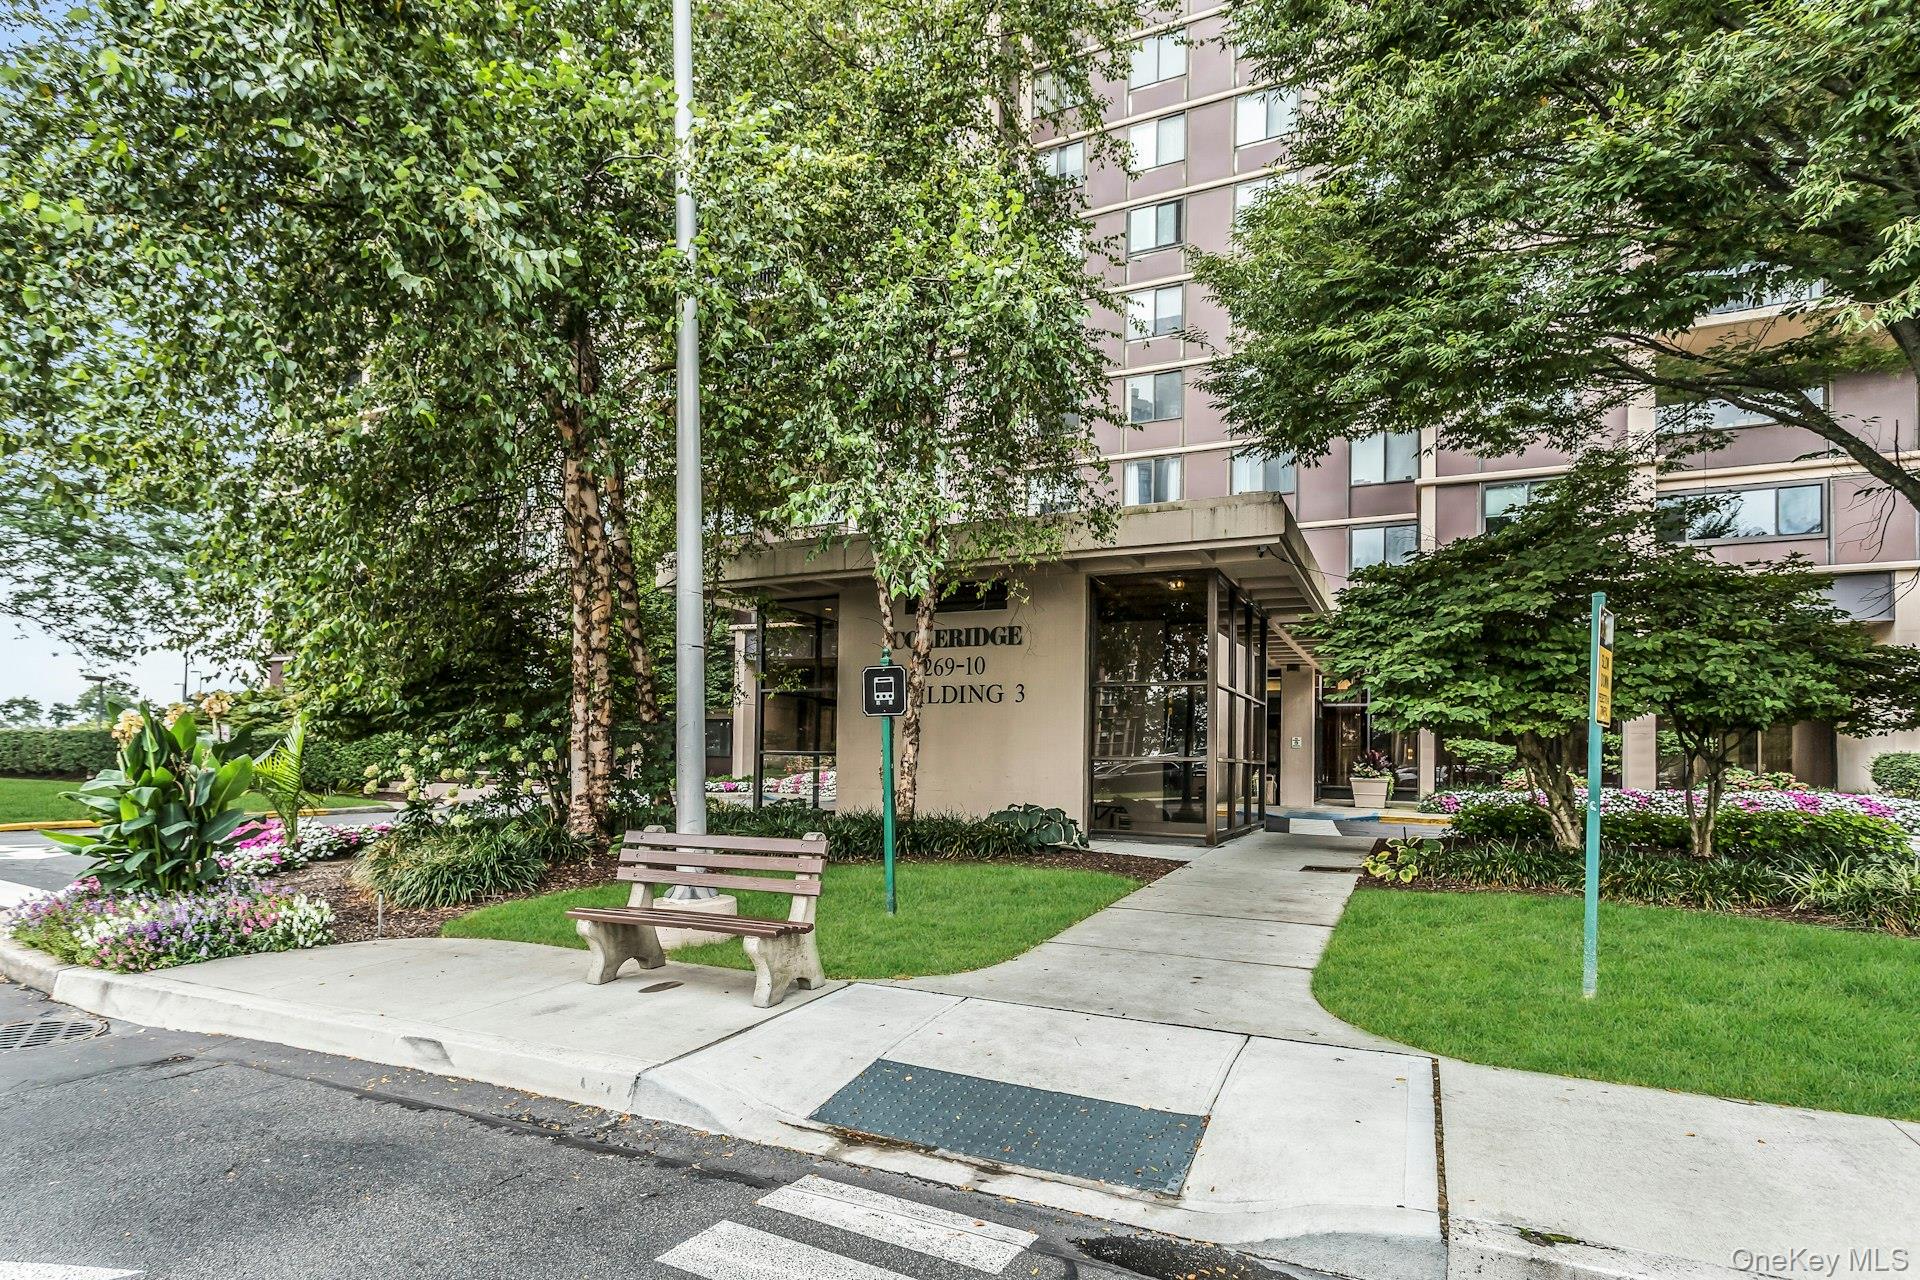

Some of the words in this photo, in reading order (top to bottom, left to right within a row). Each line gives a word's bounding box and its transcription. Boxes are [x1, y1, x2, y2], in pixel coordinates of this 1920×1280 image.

[893, 625, 1023, 650] COERIDGE
[924, 655, 986, 677] 269-10
[922, 684, 1004, 705] LDING
[1015, 683, 1026, 704] 3
